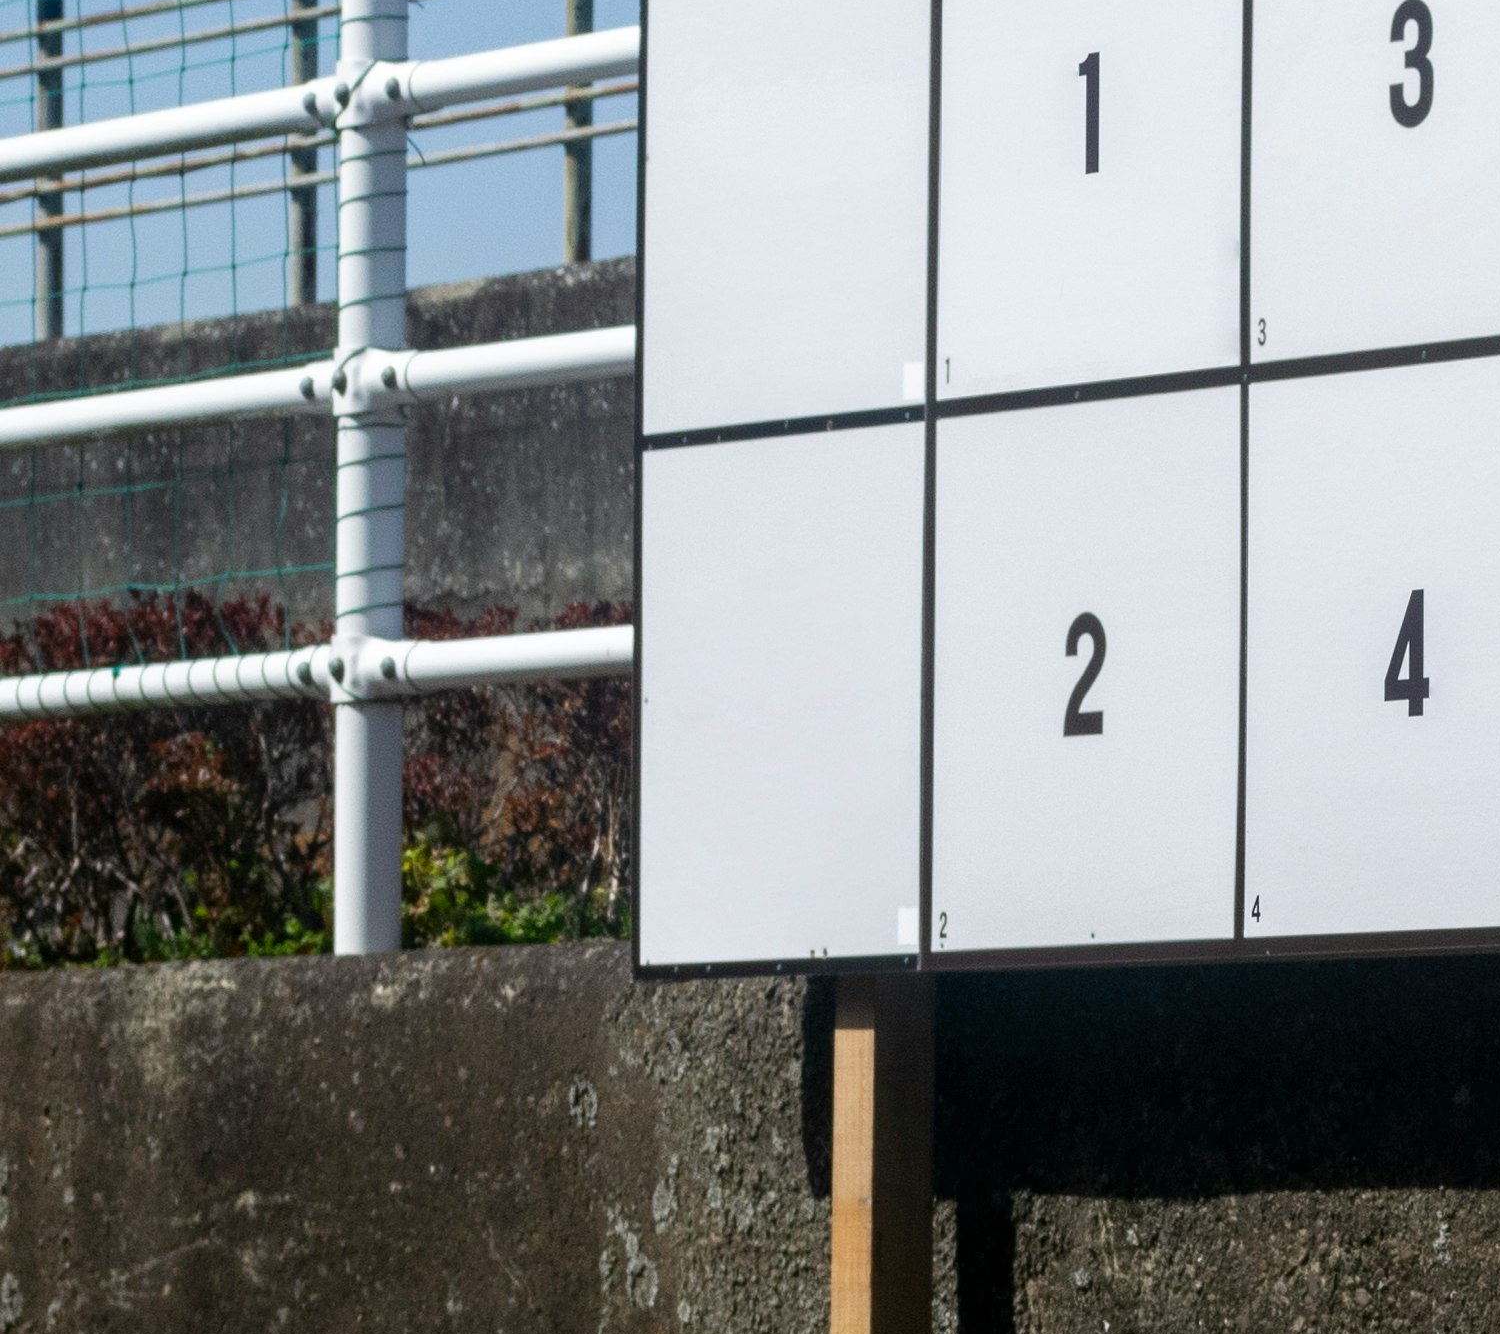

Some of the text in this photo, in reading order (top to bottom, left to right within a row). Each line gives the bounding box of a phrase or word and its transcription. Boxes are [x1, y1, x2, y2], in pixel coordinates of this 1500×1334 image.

[1079, 52, 1100, 174] 1
[1257, 317, 1267, 347] 3
[944, 357, 951, 385] 1
[1384, 589, 1429, 717] 4
[1063, 612, 1107, 737] 2
[1251, 894, 1262, 923] 4
[939, 911, 948, 939] 2
